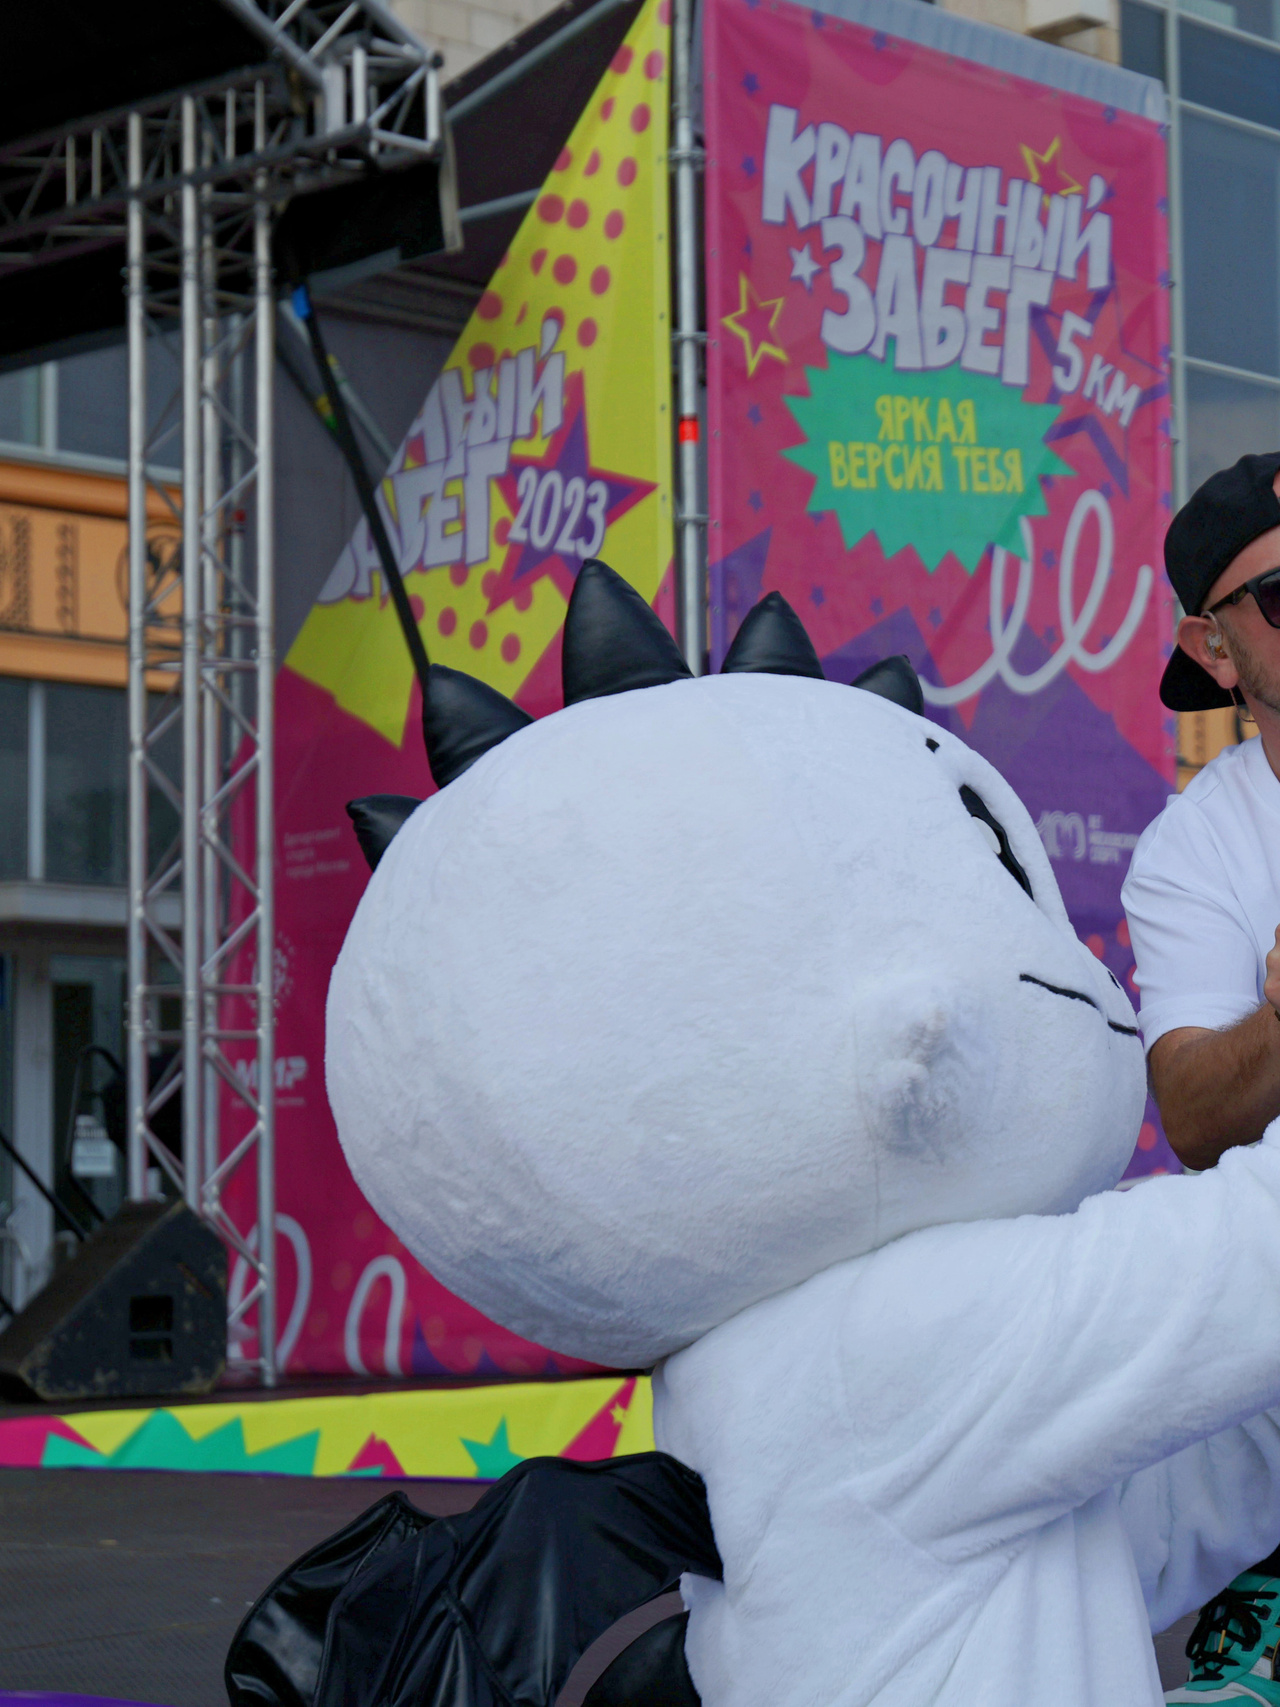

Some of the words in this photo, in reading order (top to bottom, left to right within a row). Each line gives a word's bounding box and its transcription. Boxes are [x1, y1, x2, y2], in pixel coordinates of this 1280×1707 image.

[762, 102, 1112, 290] КРАСОЧНЫЙ
[820, 214, 1055, 386] ЗАБЕГ
[1053, 311, 1093, 393] 5
[875, 393, 977, 444] ЯРКАЯ
[828, 442, 943, 490] ВЕРСИЯ
[951, 448, 1025, 494] ТЕБЯ
[508, 465, 608, 561] 2023
